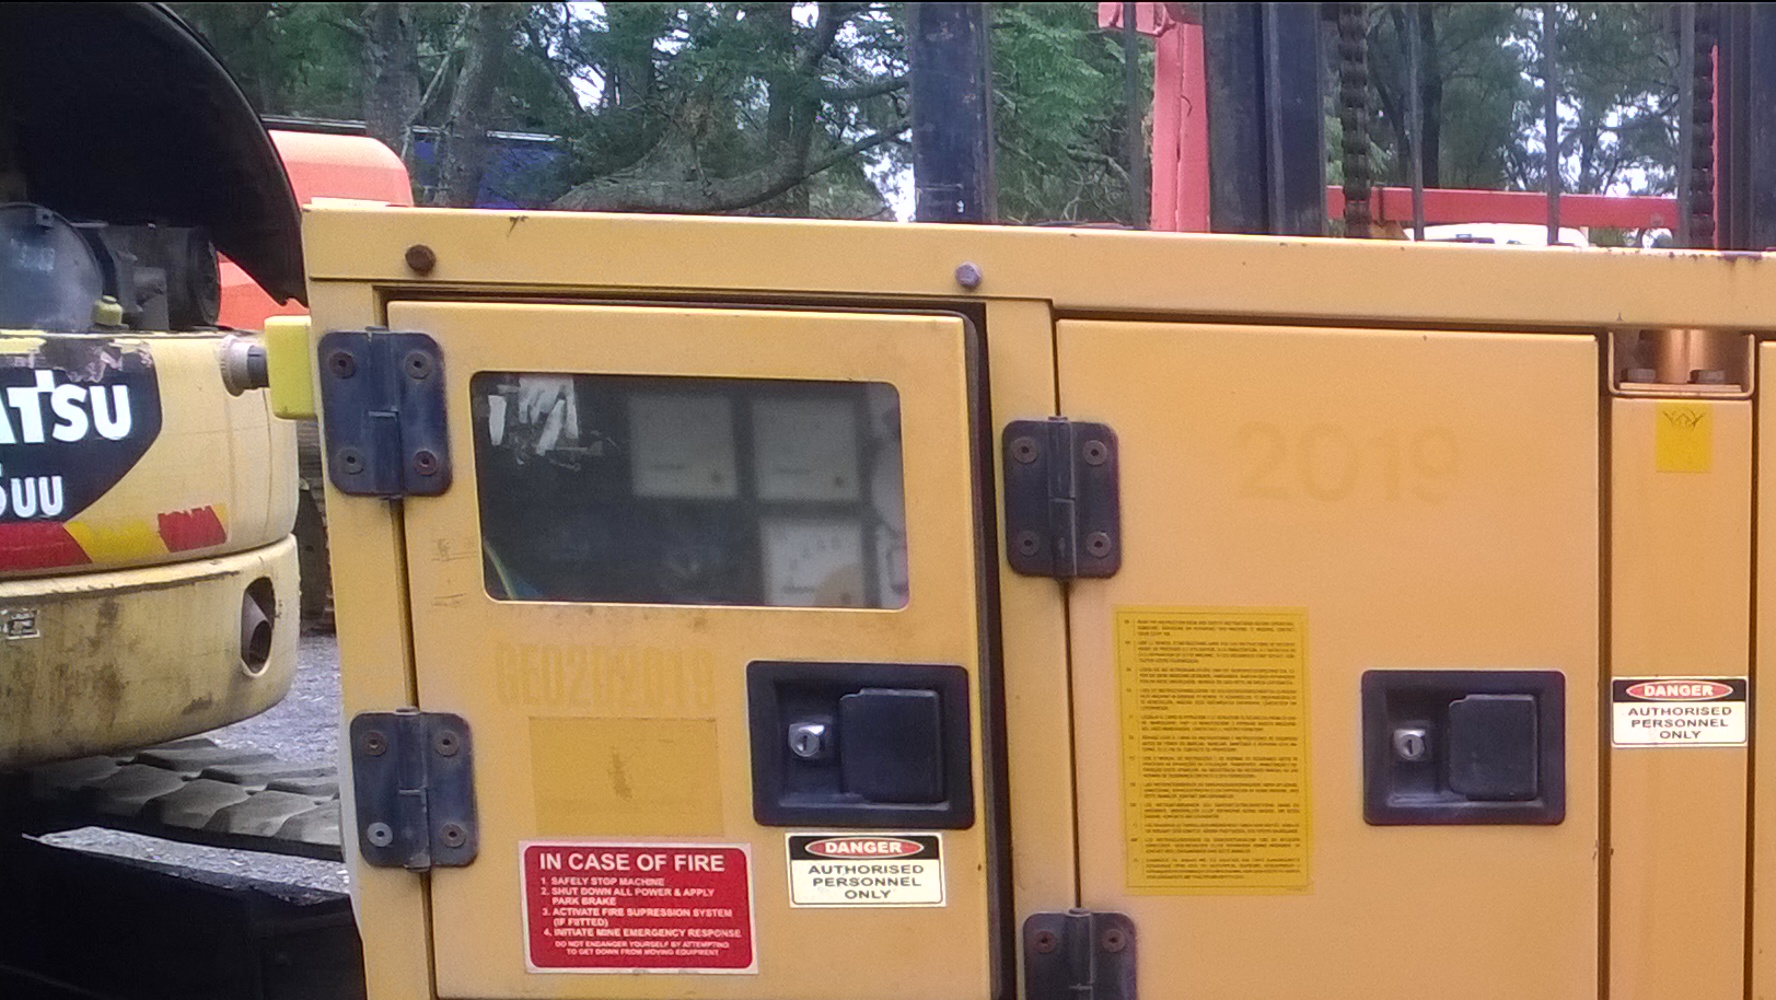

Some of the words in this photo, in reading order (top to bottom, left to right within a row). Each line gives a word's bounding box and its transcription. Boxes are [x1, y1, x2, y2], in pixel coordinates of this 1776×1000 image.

[1236, 420, 1461, 505] 2019
[0, 464, 63, 519] UU
[1643, 684, 1715, 697] DANGER
[1628, 706, 1732, 716] AUTHORISED
[1631, 718, 1729, 728] PERSONNEL
[1659, 730, 1702, 739] ONLY
[824, 841, 903, 853] DANGER
[540, 853, 561, 870] IN
[568, 853, 630, 871] CASE
[636, 854, 667, 871] OF
[674, 854, 726, 872] FIRE
[808, 864, 924, 875] AUTHORISED
[551, 877, 588, 886] SAFELY
[590, 877, 617, 886] STOP
[619, 877, 665, 886] MACHINE
[812, 877, 922, 887] PERSONNEL
[551, 887, 579, 896] SHUT
[580, 887, 611, 896] DOWN
[613, 887, 633, 896] ALL
[634, 888, 672, 897] POWER
[674, 888, 681, 897] &
[683, 888, 715, 898] APPLY
[844, 889, 891, 899] ONLY
[552, 896, 580, 906] PARK
[581, 897, 617, 906] BRAKE
[552, 907, 600, 916] ACTIVATE
[602, 907, 625, 916] FIRE
[626, 907, 691, 917] SUPRESSION
[692, 908, 733, 917] SYSTEM
[553, 917, 566, 928] (IF
[567, 918, 609, 928] FITTED)
[543, 928, 553, 937] 4.
[554, 928, 595, 937] INITIATE
[596, 928, 621, 937] MINE
[623, 928, 686, 937] EMERGENCY
[687, 928, 742, 938] RESPONSE
[555, 940, 567, 948] DO
[568, 940, 584, 948] NOT
[585, 940, 628, 948] ENDANGER
[682, 941, 730, 949] ATTEMPTING
[566, 948, 577, 956] TO
[578, 948, 594, 956] GET
[595, 948, 619, 956] DOWN
